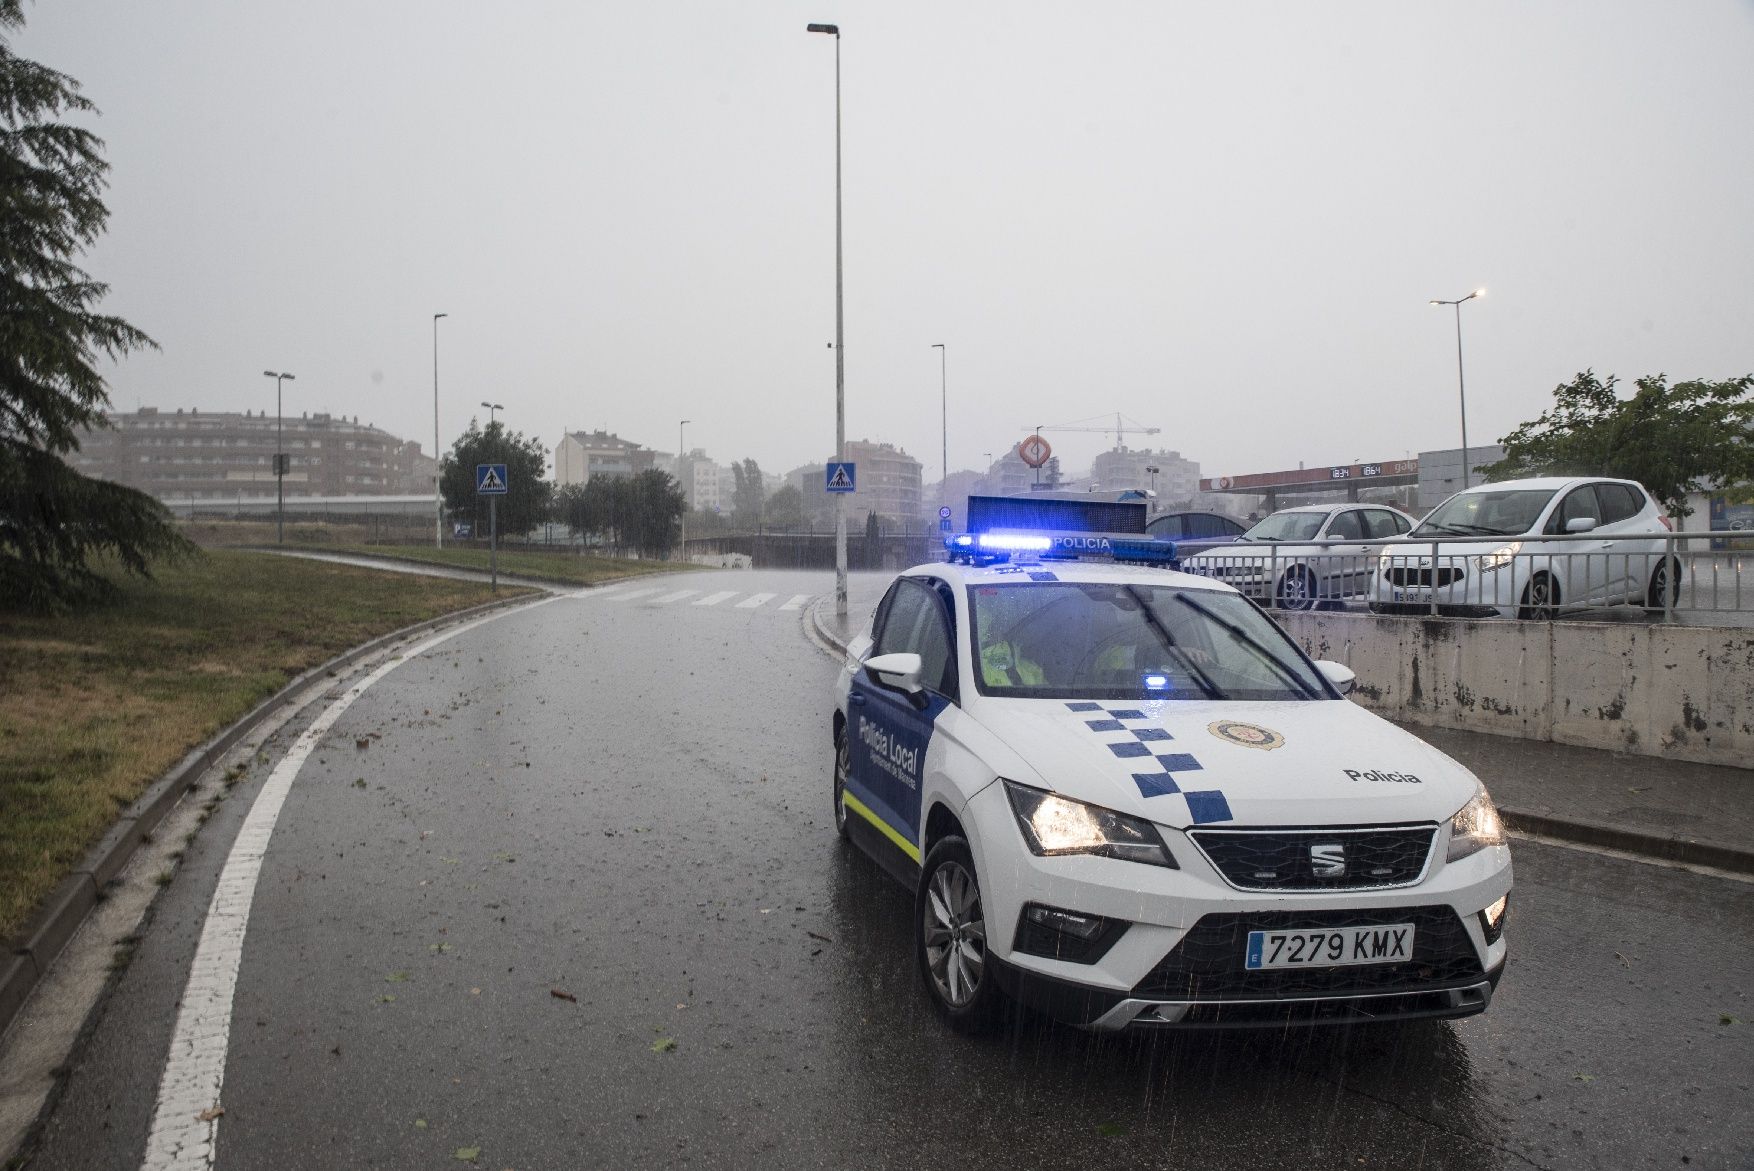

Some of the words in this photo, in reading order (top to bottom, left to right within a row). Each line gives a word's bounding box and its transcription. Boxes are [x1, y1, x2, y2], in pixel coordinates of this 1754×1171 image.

[1394, 460, 1417, 474] galp
[1053, 537, 1111, 549] POLICIA
[889, 733, 919, 776] Local
[1342, 769, 1423, 785] Policia
[1268, 932, 1345, 964] 7279
[1352, 928, 1408, 960] KMX
